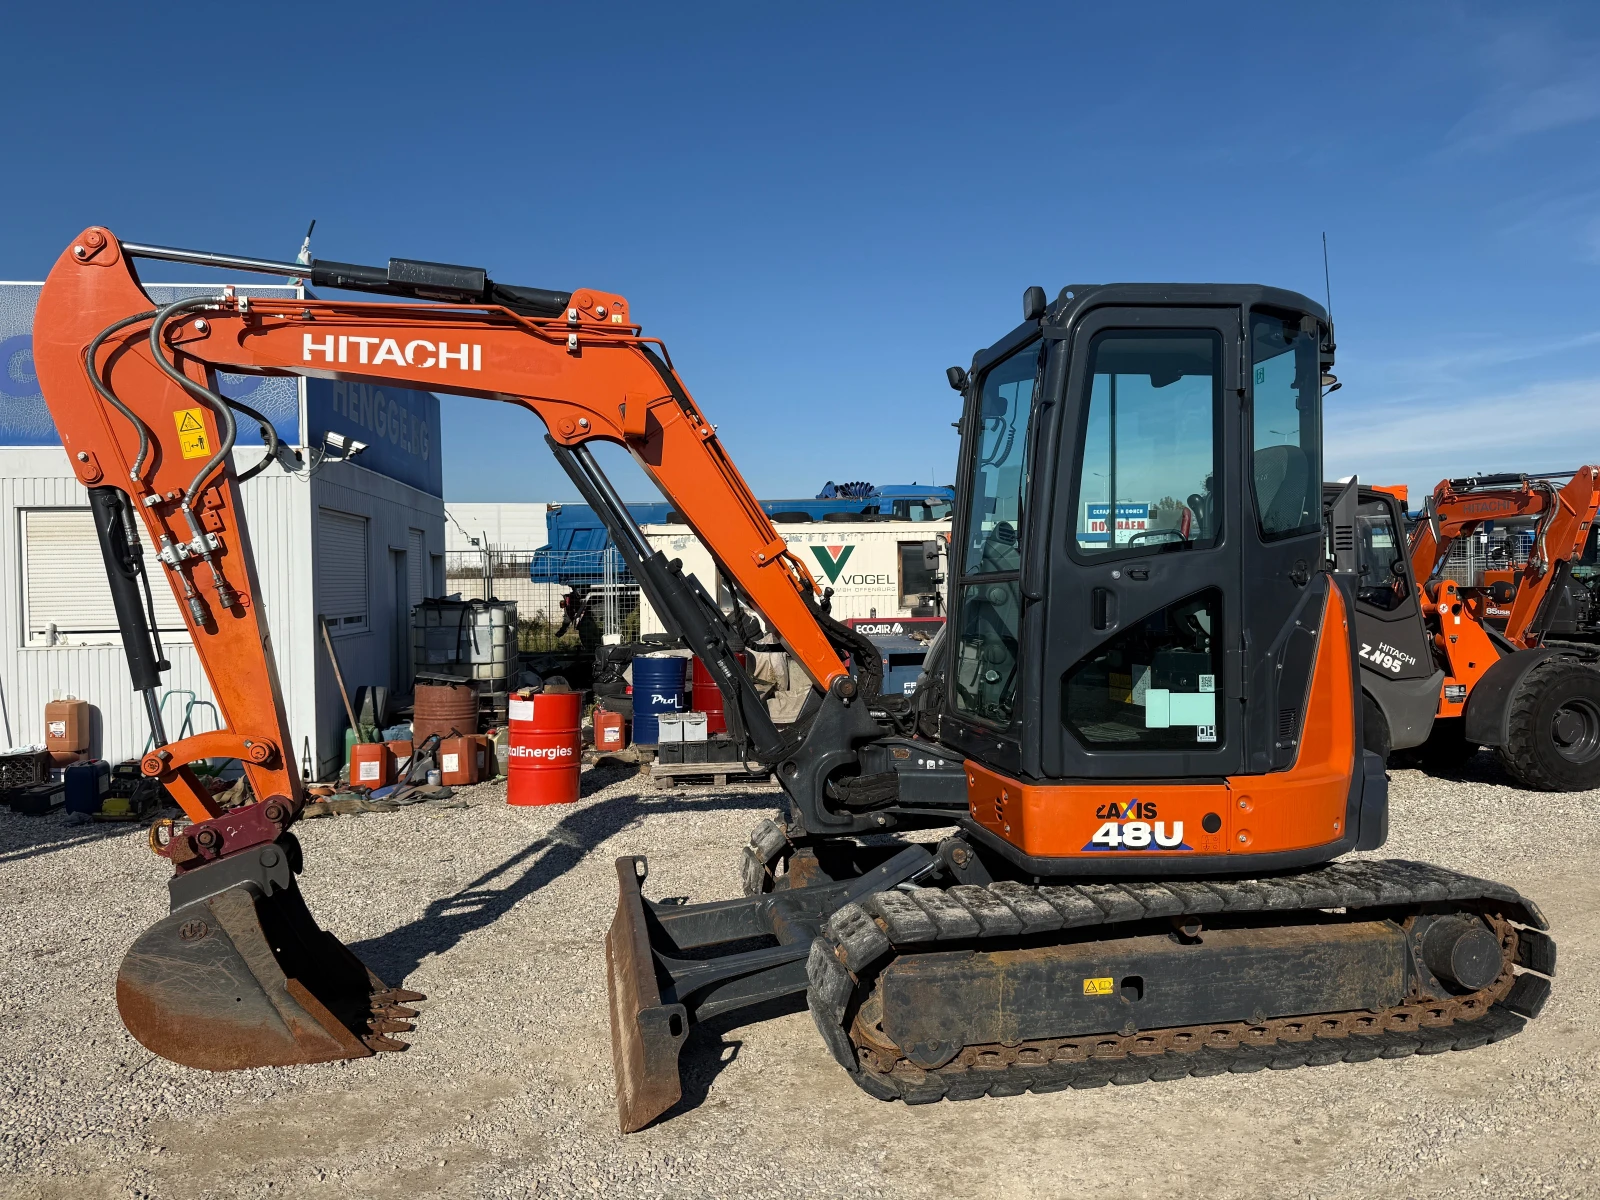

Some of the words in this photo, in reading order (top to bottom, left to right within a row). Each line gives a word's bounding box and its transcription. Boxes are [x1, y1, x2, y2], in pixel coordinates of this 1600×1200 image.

[303, 333, 482, 371] HITACHI
[333, 381, 430, 461] HENGGE.BG
[1463, 501, 1511, 514] HITACHI
[1117, 521, 1145, 530] НАЕМ
[841, 574, 896, 585] VOGEL
[856, 624, 891, 634] ECOAIR
[1378, 641, 1416, 666] HITACHI
[1096, 798, 1157, 819] ZAXIS
[1092, 821, 1184, 850] 48U
